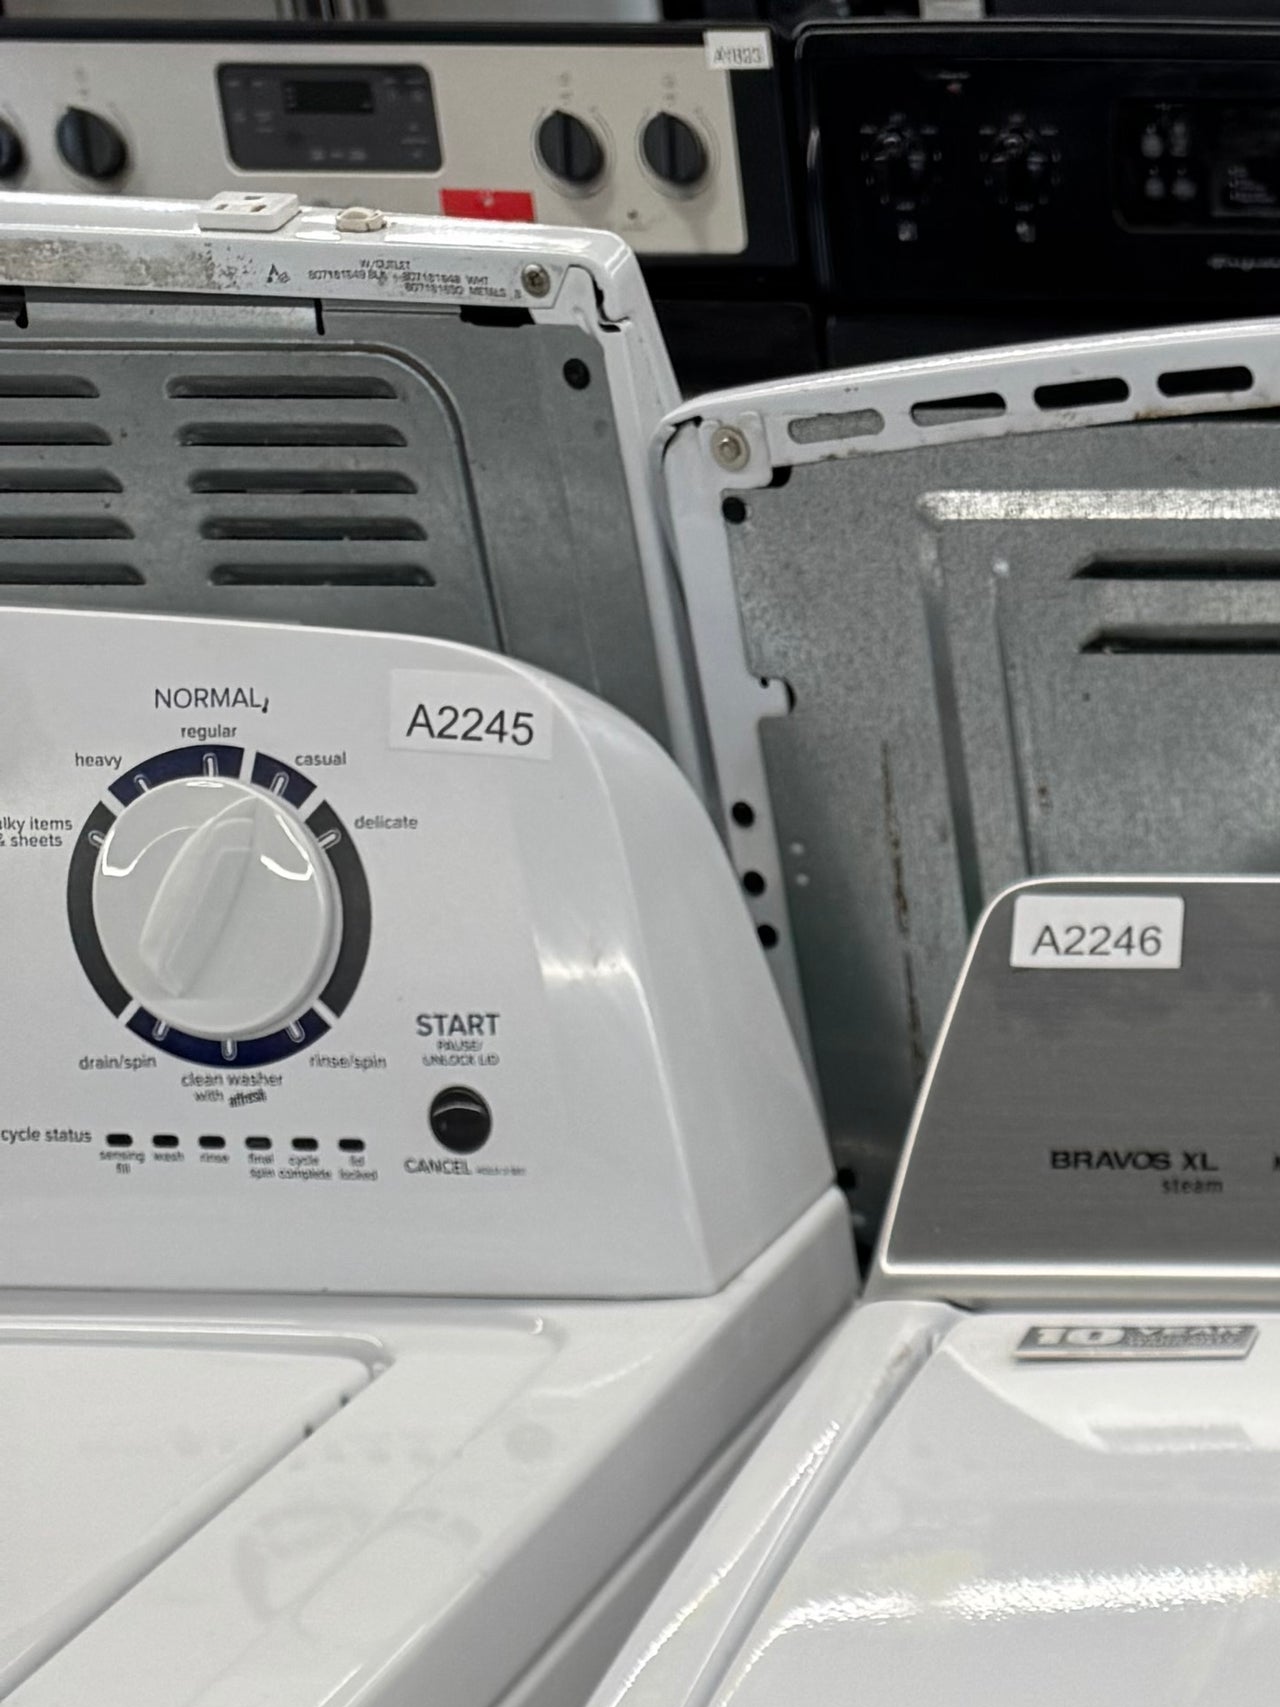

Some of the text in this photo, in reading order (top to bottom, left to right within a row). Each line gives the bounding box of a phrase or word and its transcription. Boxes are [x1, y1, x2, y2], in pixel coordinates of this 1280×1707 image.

[180, 724, 238, 741] regular
[405, 703, 535, 747] A2245
[75, 751, 123, 769] heavy
[294, 750, 347, 767] casual
[29, 815, 74, 831] items
[353, 814, 419, 831] delicate
[10, 833, 64, 848] sheets
[1031, 924, 1164, 957] A2246
[415, 1012, 501, 1038] START
[78, 1053, 157, 1072] drain/spin
[180, 1071, 283, 1088] clean washer
[0, 1125, 93, 1145] cycle status
[403, 1157, 473, 1176] CANCEL
[1050, 1150, 1220, 1172] BRAVOS XL
[1161, 1177, 1224, 1195] steam
[1037, 1327, 1126, 1346] 10
